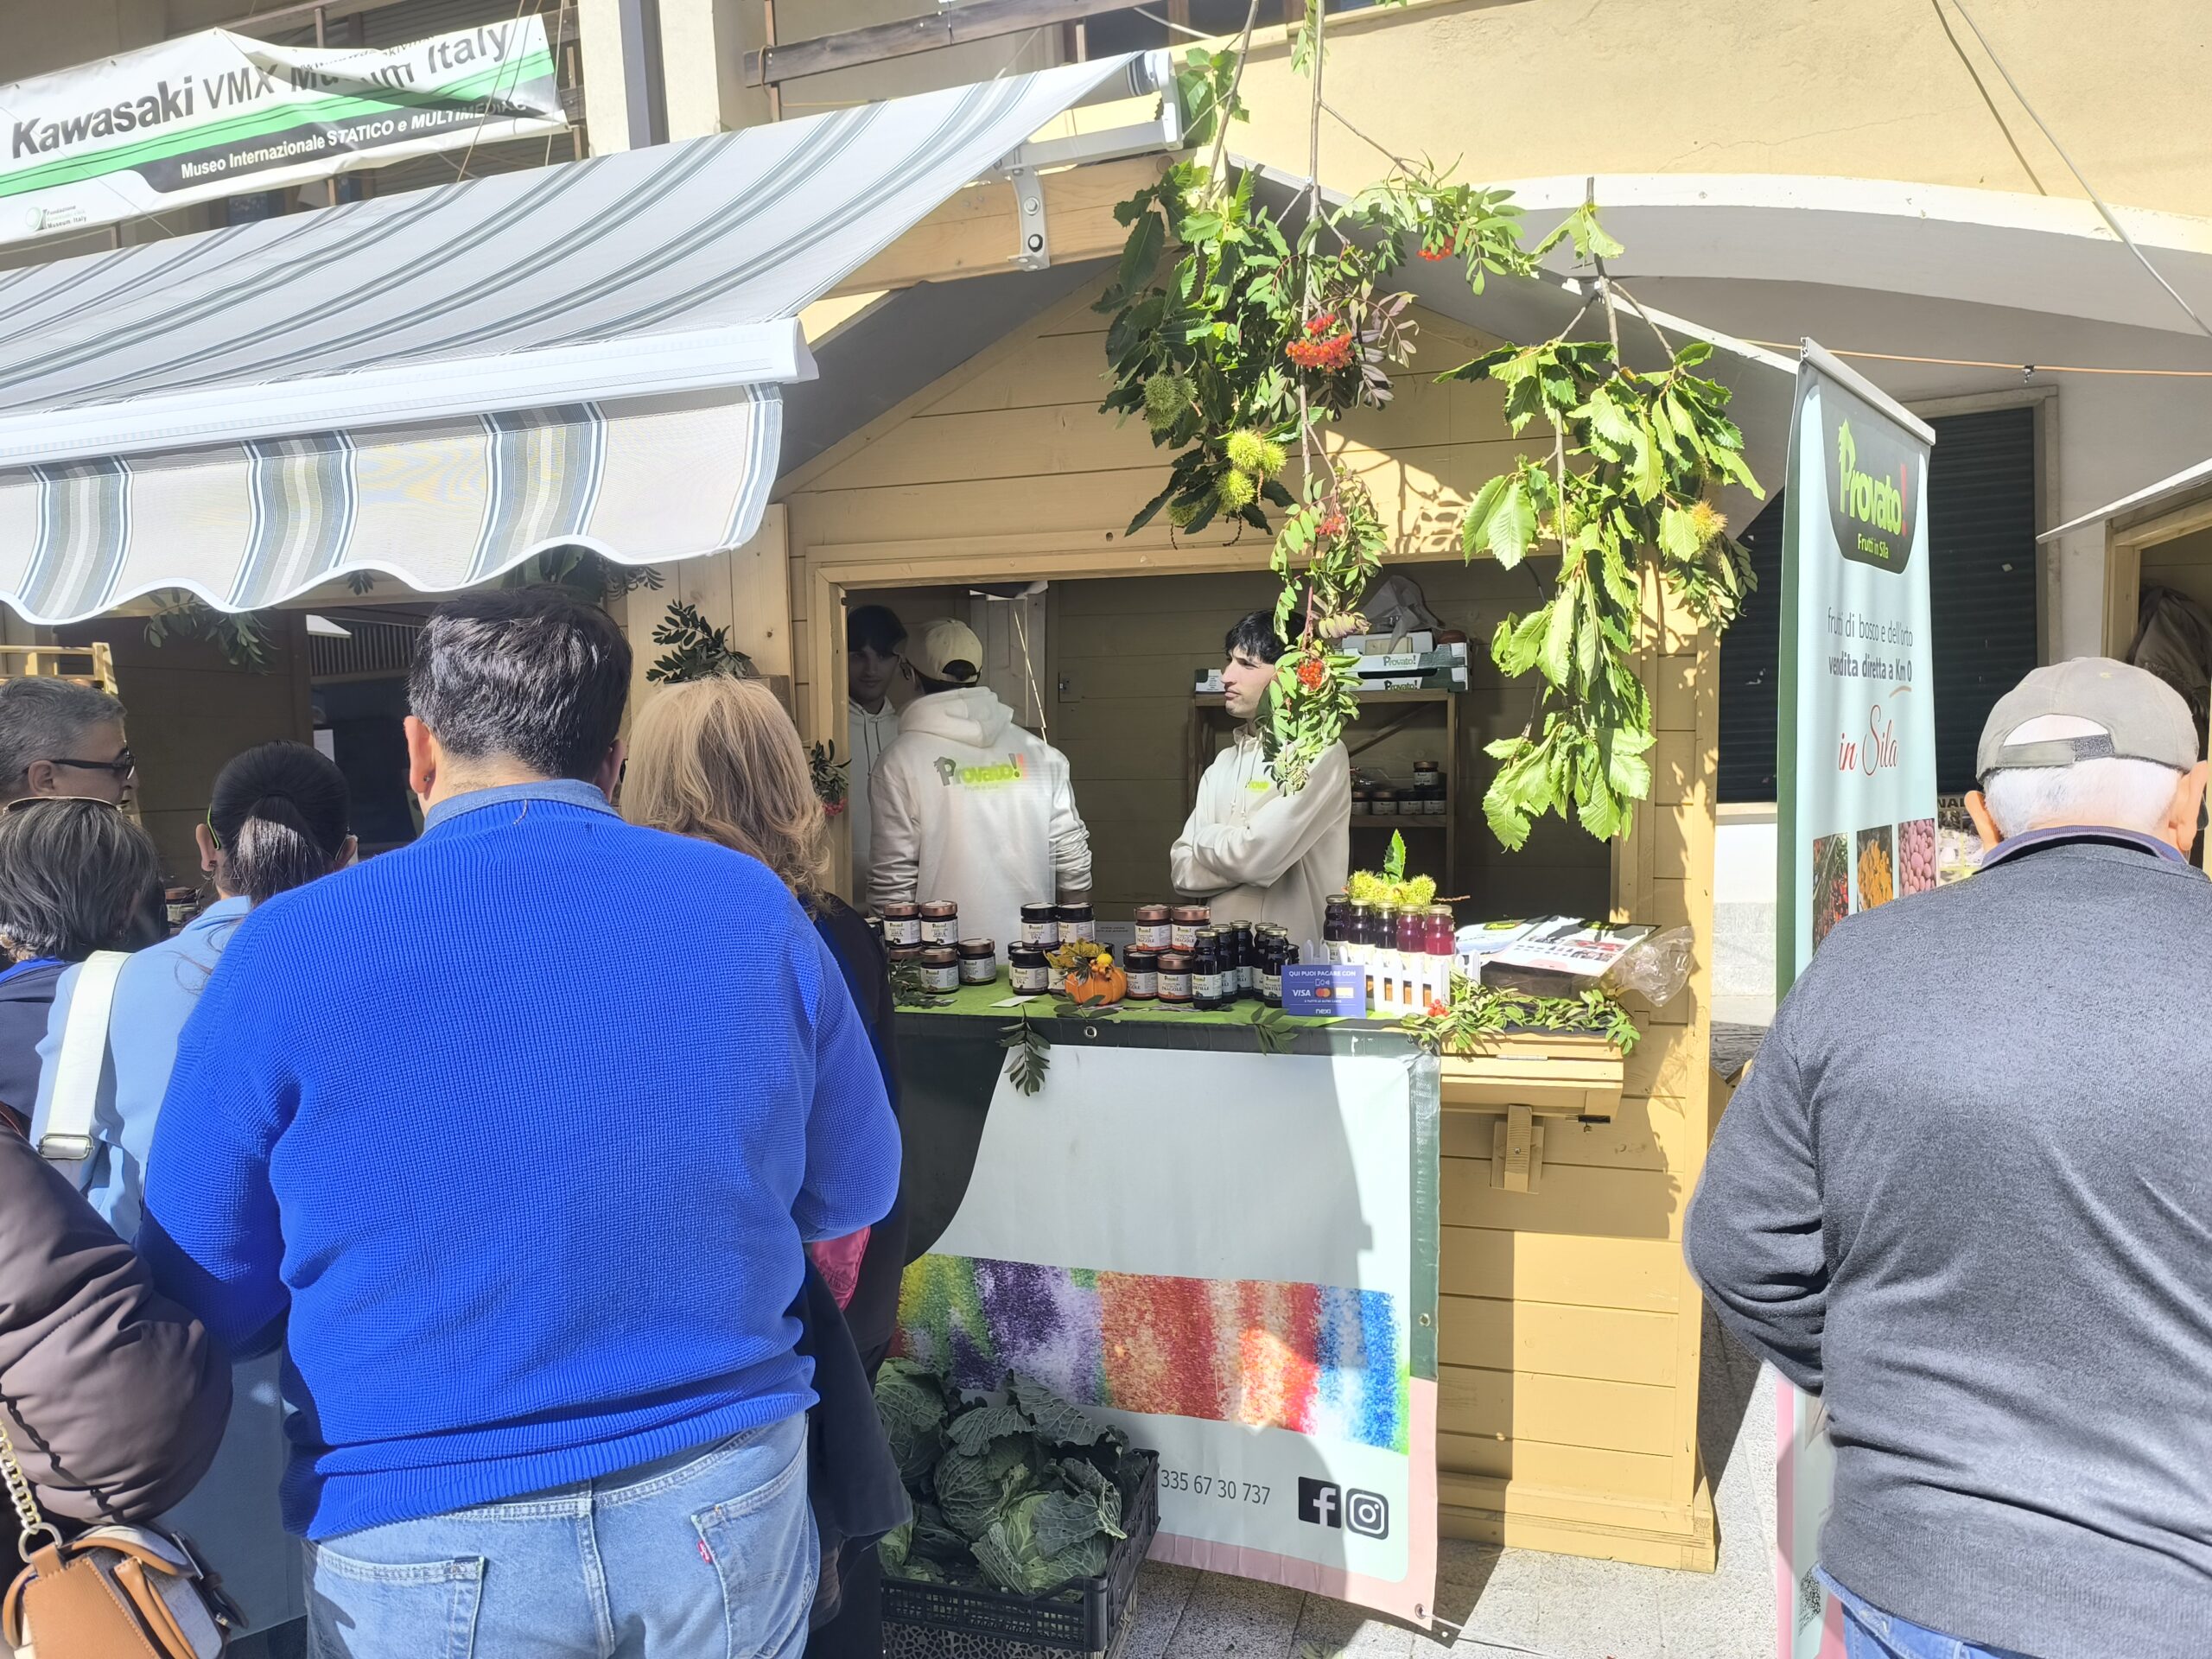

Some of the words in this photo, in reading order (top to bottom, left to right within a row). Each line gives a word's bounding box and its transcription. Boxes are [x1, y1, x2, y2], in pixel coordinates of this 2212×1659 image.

[12, 74, 194, 159] Kawasaki
[202, 63, 278, 110] VMX
[428, 22, 509, 74] Italy
[181, 158, 226, 179] Museo
[229, 134, 325, 168] Internazionale
[327, 120, 395, 147] STATICO
[397, 121, 408, 132] e
[1838, 418, 1908, 537] Provato!
[1858, 532, 1874, 553] Frutti
[1879, 540, 1890, 559] Sila
[1845, 612, 1855, 638] di
[1859, 613, 1879, 642] bosco
[1880, 625, 1886, 643] e
[1382, 654, 1417, 667] Provato!
[1828, 650, 1859, 678] vendita
[1861, 652, 1887, 680] diretta
[1888, 663, 1893, 681] a
[1895, 658, 1906, 682] Km
[1383, 679, 1421, 690] Provato!
[1838, 732, 1858, 771] in
[1861, 703, 1898, 776] Sila
[1160, 1469, 1189, 1491] 335
[1193, 1475, 1213, 1496] 67
[1217, 1479, 1237, 1500] 30
[1243, 1483, 1271, 1505] 737
